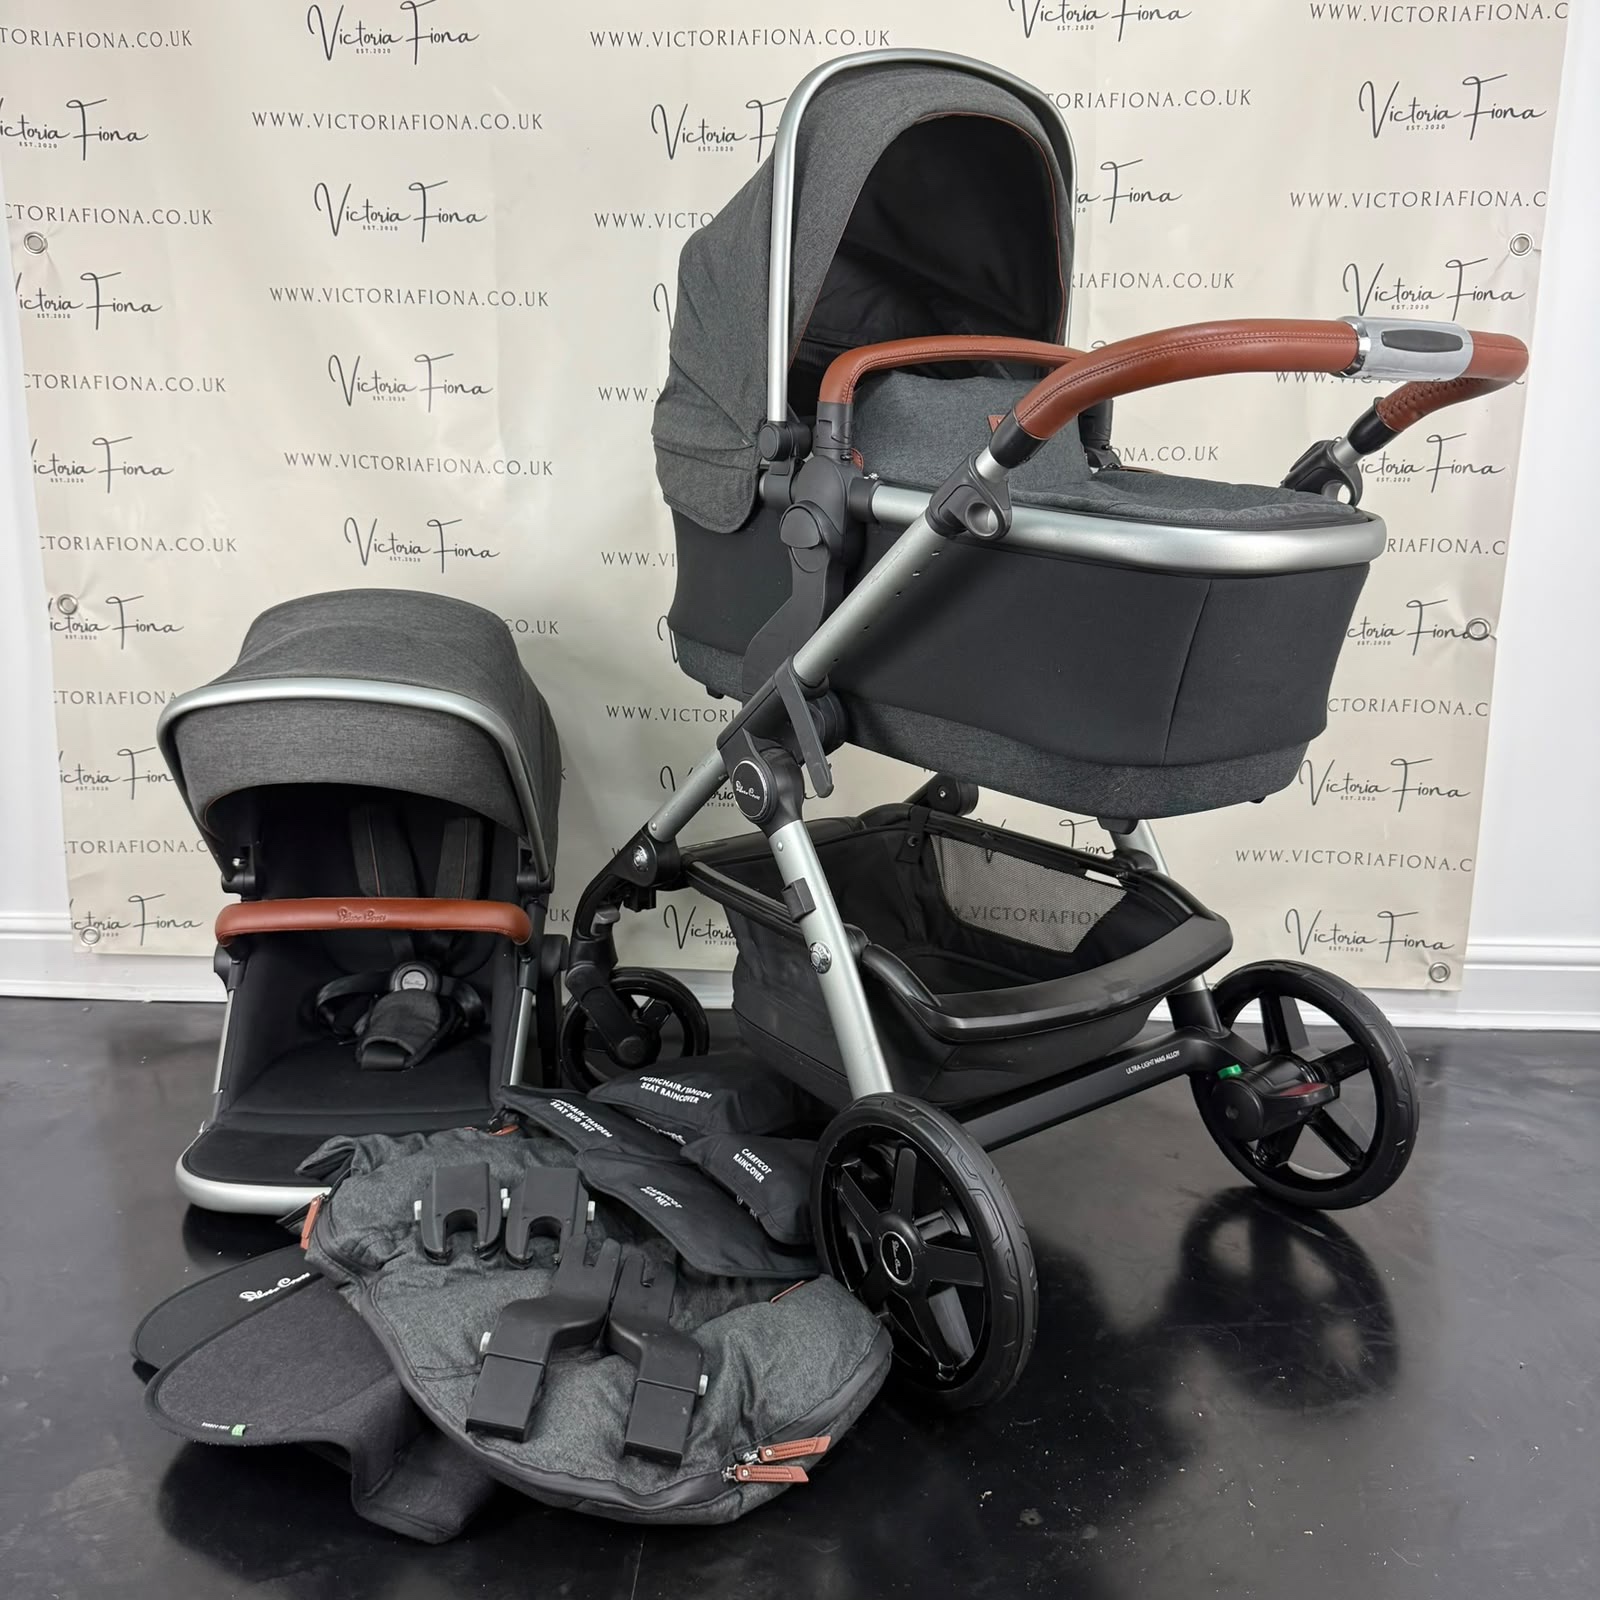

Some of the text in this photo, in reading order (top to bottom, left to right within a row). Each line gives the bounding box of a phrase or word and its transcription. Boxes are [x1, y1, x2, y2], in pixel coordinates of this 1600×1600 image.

[307, 0, 480, 65] Victoria Fiona
[590, 29, 893, 50] WWW.VICTORIAFIONA.CO.UK
[1310, 2, 1568, 22] WWW.VICTORIAFIONA.C
[0, 98, 148, 161] ictoria Fiona
[252, 112, 542, 130] WWW.VICTORIAFIONA.CO.UK
[651, 104, 747, 160] Victoria
[1359, 74, 1547, 140] Victoria Fiona
[314, 180, 487, 242] Victoria Fiona
[1100, 159, 1183, 223] Fiona
[1290, 191, 1546, 208] WWW.VICTORIAFIONA.C
[80, 271, 162, 330] Fiona
[270, 288, 548, 306] WWW.VICTORIAFIONA.CO.UK
[1071, 272, 1235, 289] IAFIONA.CO.UK
[1343, 258, 1526, 321] Victoria Fiona
[328, 353, 493, 413] Victoria Fiona
[31, 436, 174, 493] ictoria Fiona
[284, 453, 552, 475] WWW.VICTORIAFIONA.CO.UK
[1427, 433, 1506, 493] Fiona
[344, 517, 500, 573] Victoria Fiona
[105, 595, 184, 650] Fiona
[1299, 758, 1471, 813] Victoria Fiona
[1236, 850, 1472, 872] WWW.VICTORIAFIONA.C
[128, 893, 204, 946] Fiona
[1285, 909, 1455, 963] Victoria Fiona
